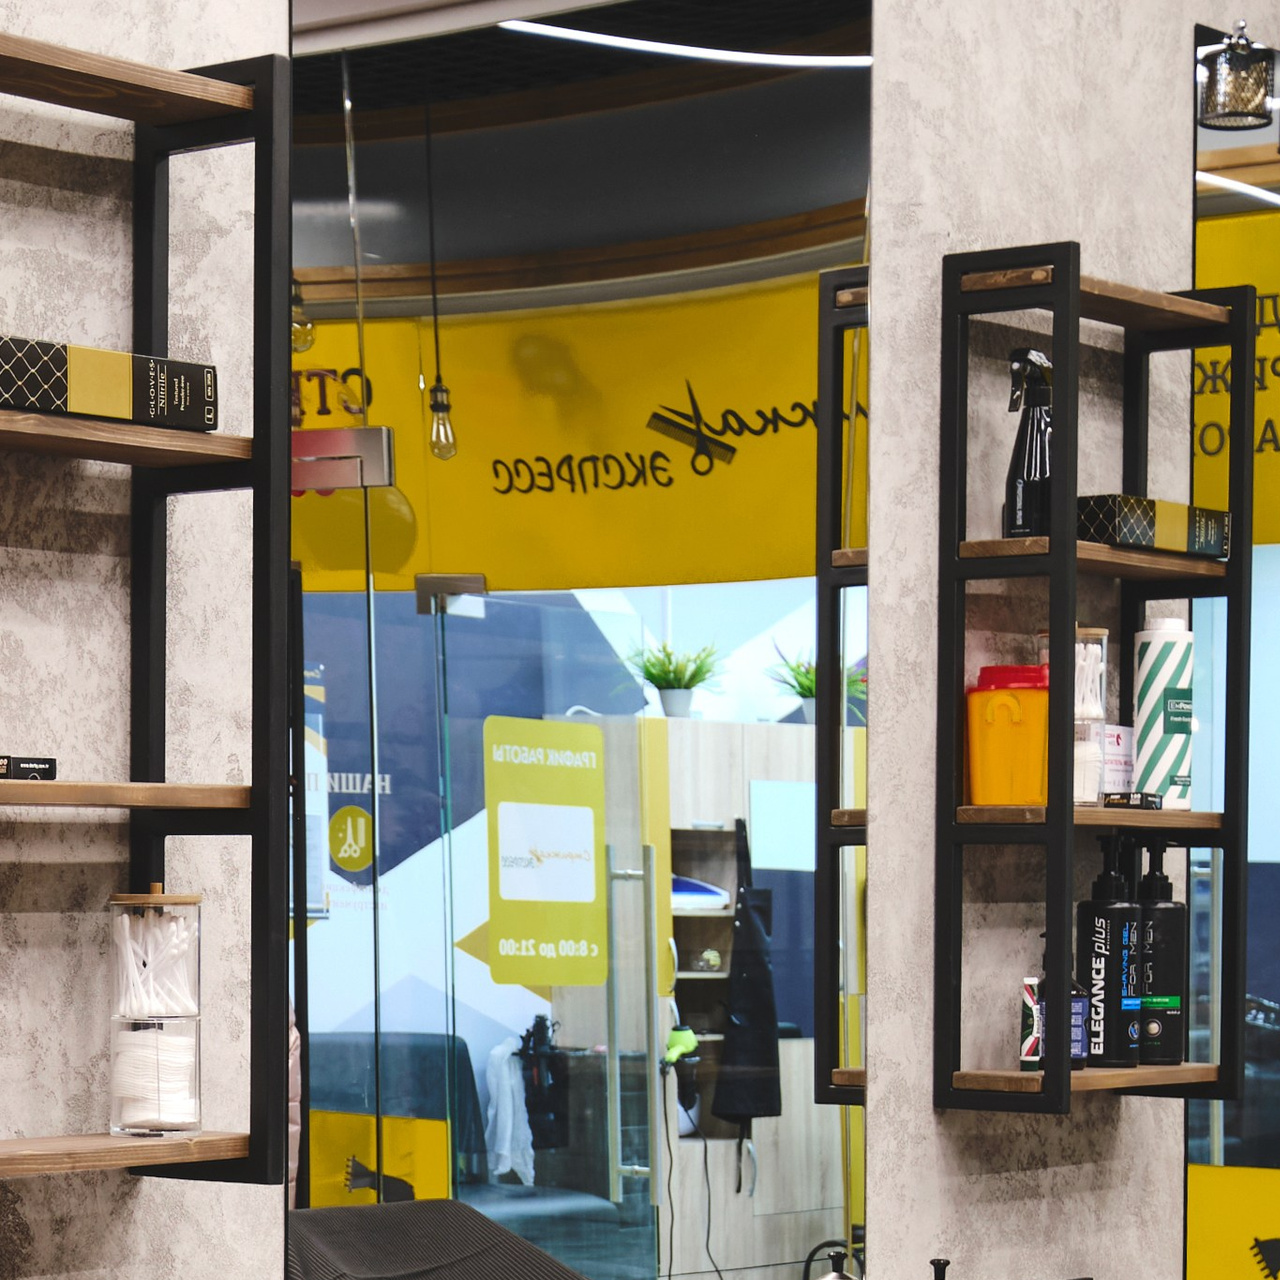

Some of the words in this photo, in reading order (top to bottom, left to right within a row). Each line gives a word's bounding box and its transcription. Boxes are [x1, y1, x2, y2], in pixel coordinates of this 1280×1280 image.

[1092, 916, 1110, 955] plus
[1129, 921, 1137, 955] MEN
[1143, 920, 1153, 953] MEN
[1128, 963, 1137, 996] FOR
[1090, 956, 1105, 1055] ELEGANCE
